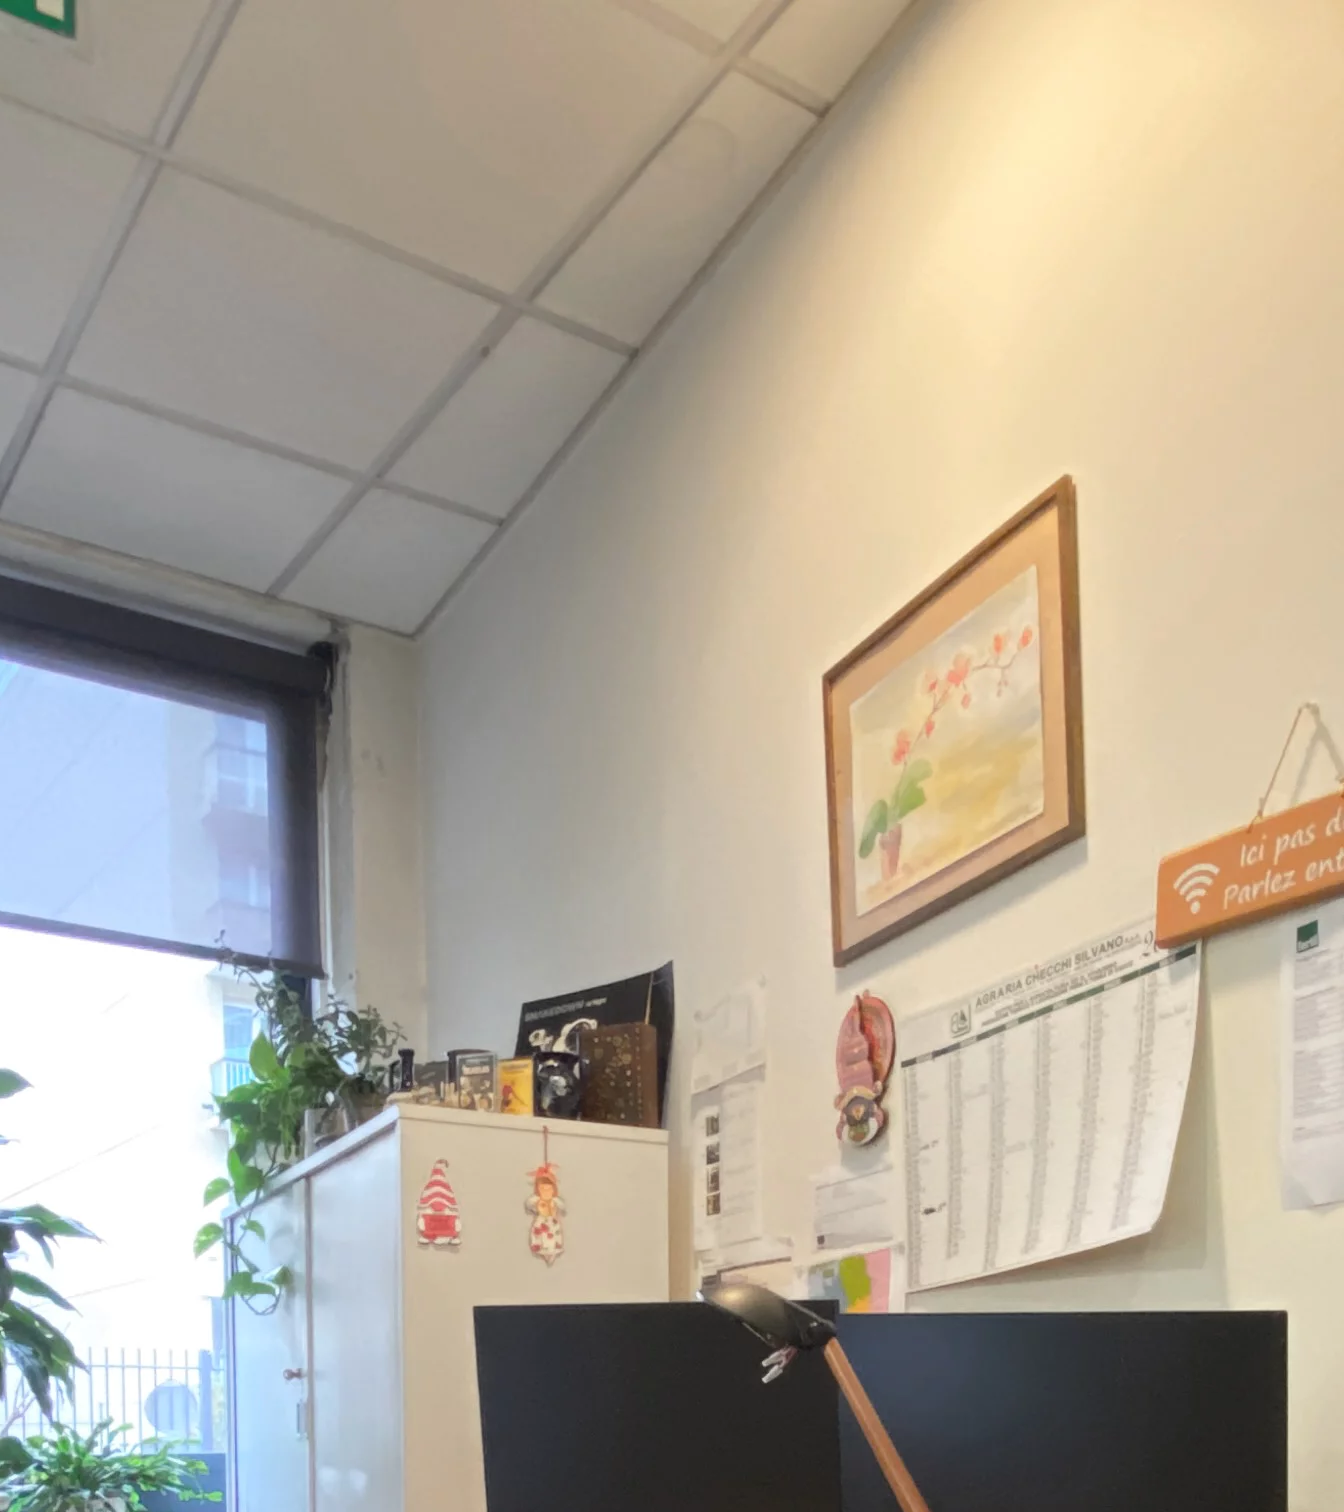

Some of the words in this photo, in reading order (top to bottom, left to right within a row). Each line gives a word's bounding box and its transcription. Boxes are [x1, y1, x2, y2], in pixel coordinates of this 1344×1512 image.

[1240, 833, 1268, 868] Ici
[1273, 823, 1316, 867] pas
[1223, 868, 1297, 911] Parlez
[975, 978, 1024, 1009] AGRARIA
[1025, 956, 1073, 987] CHECCHI
[1075, 935, 1124, 966] SILVANO
